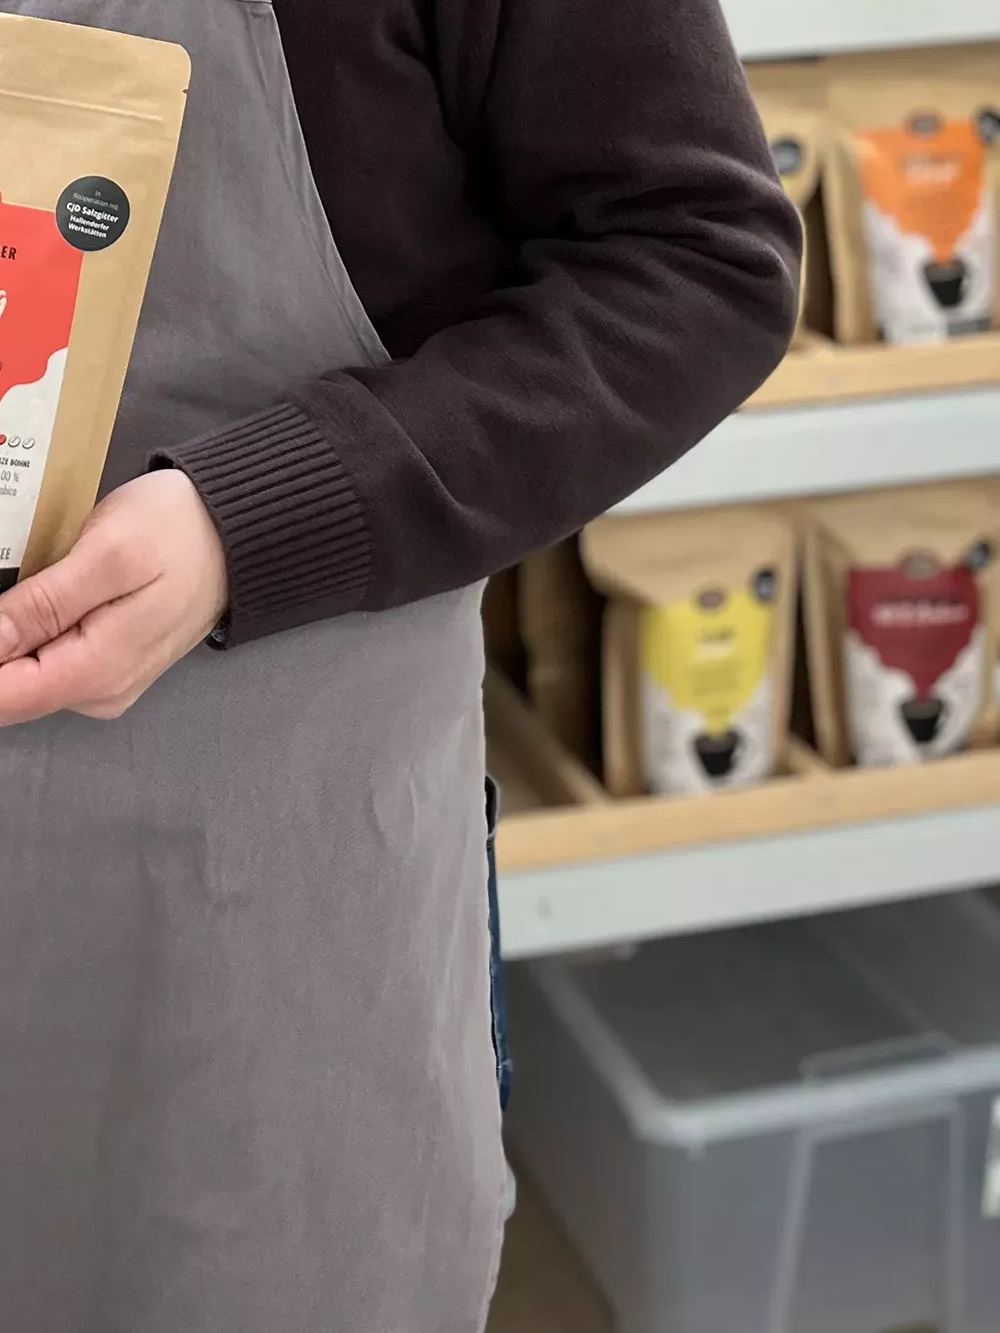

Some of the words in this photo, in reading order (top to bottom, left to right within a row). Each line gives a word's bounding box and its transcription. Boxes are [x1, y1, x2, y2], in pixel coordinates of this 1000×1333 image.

[66, 202, 81, 213] CJD
[82, 206, 119, 223] Salzgitter
[68, 222, 107, 238] Werkstätten
[69, 215, 110, 231] Hallendorfer
[13, 472, 20, 482] %
